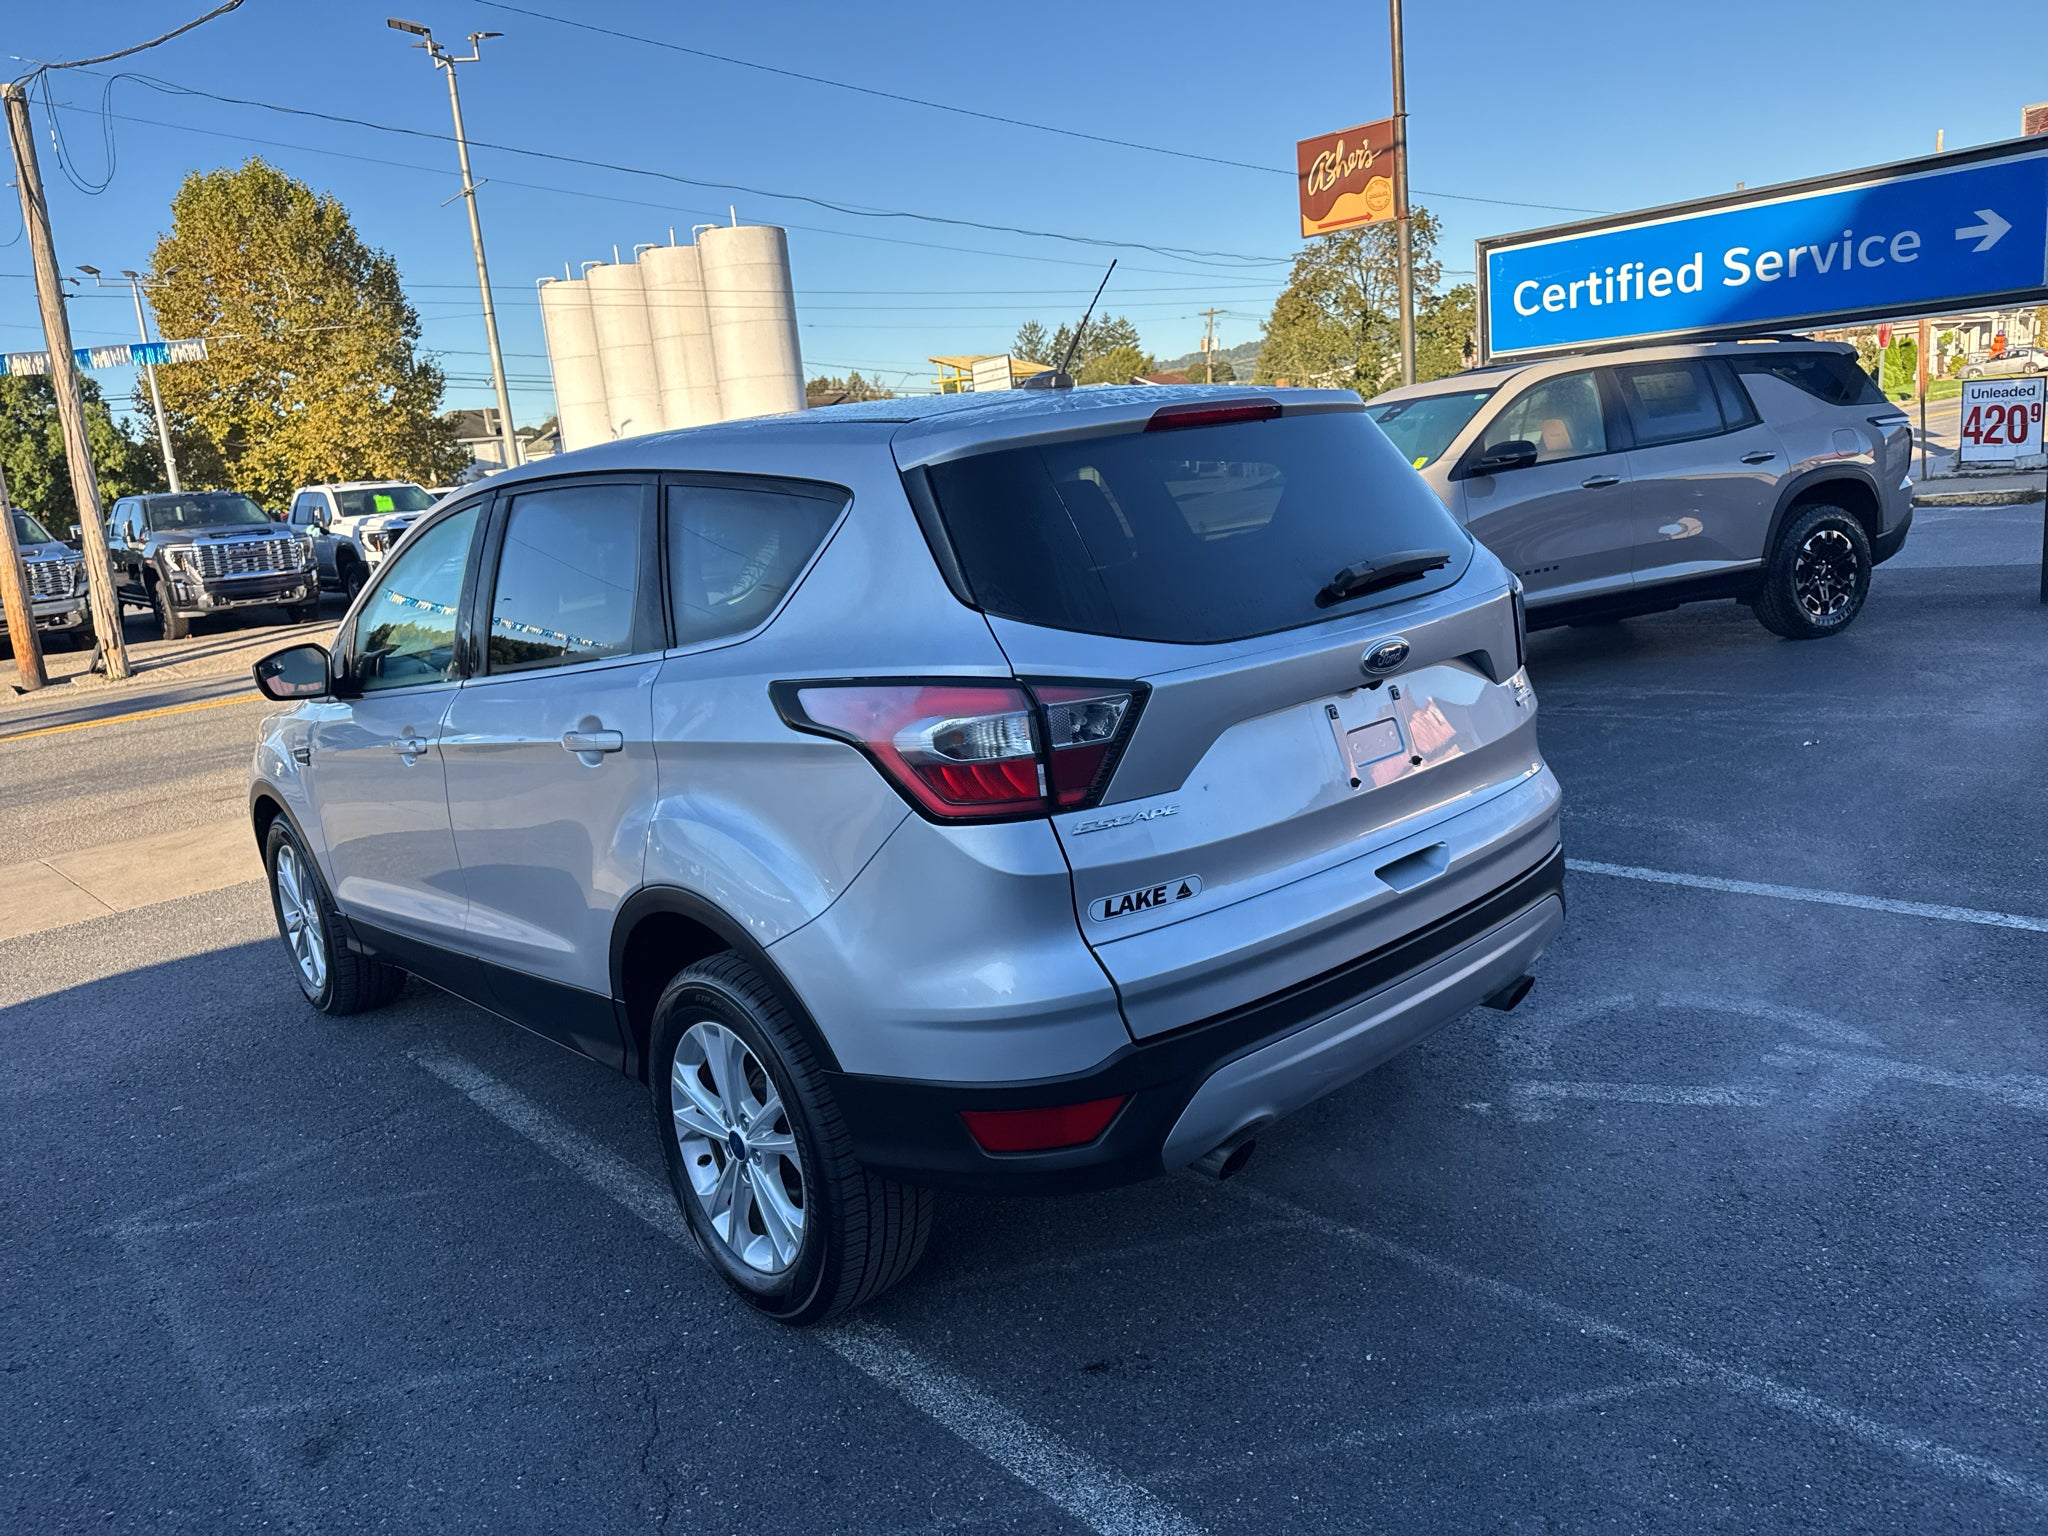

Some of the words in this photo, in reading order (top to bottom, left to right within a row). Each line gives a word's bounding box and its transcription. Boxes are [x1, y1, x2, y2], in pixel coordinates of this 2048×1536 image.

[1513, 252, 1703, 316] Certified
[1722, 229, 1920, 286] Service
[1971, 385, 2036, 400] Unleaded
[1376, 648, 1402, 667] Ford
[1072, 804, 1180, 836] ESCAPE
[1104, 885, 1167, 918] LAKE
